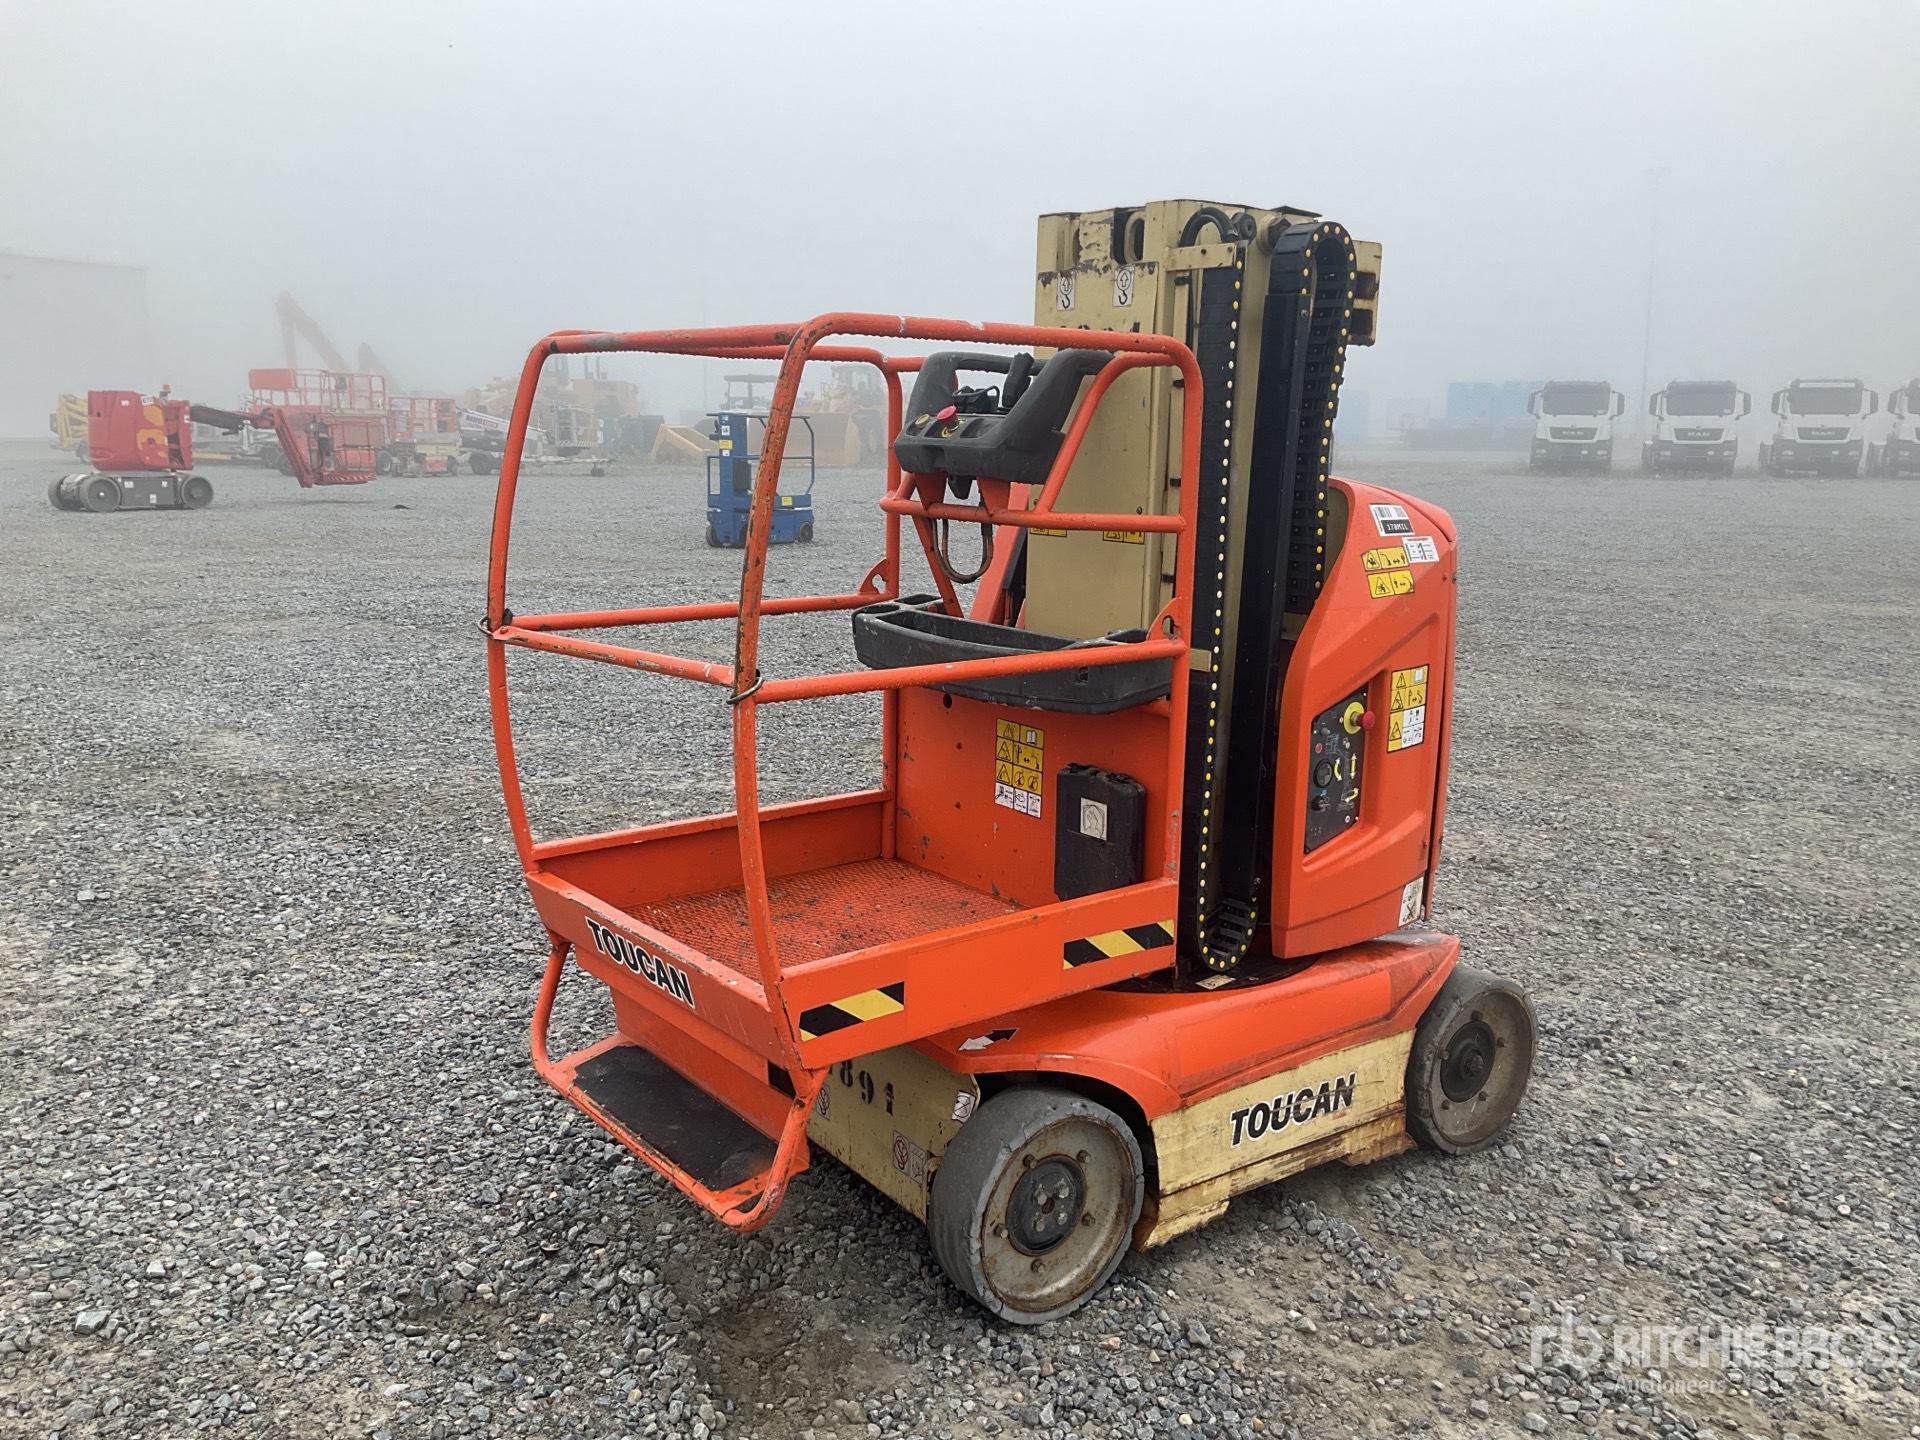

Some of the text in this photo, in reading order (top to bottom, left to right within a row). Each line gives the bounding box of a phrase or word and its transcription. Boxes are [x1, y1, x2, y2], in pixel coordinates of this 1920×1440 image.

[585, 916, 695, 1009] TOUCAN
[828, 1059, 894, 1117] 891
[1230, 1072, 1356, 1148] TOUCAN
